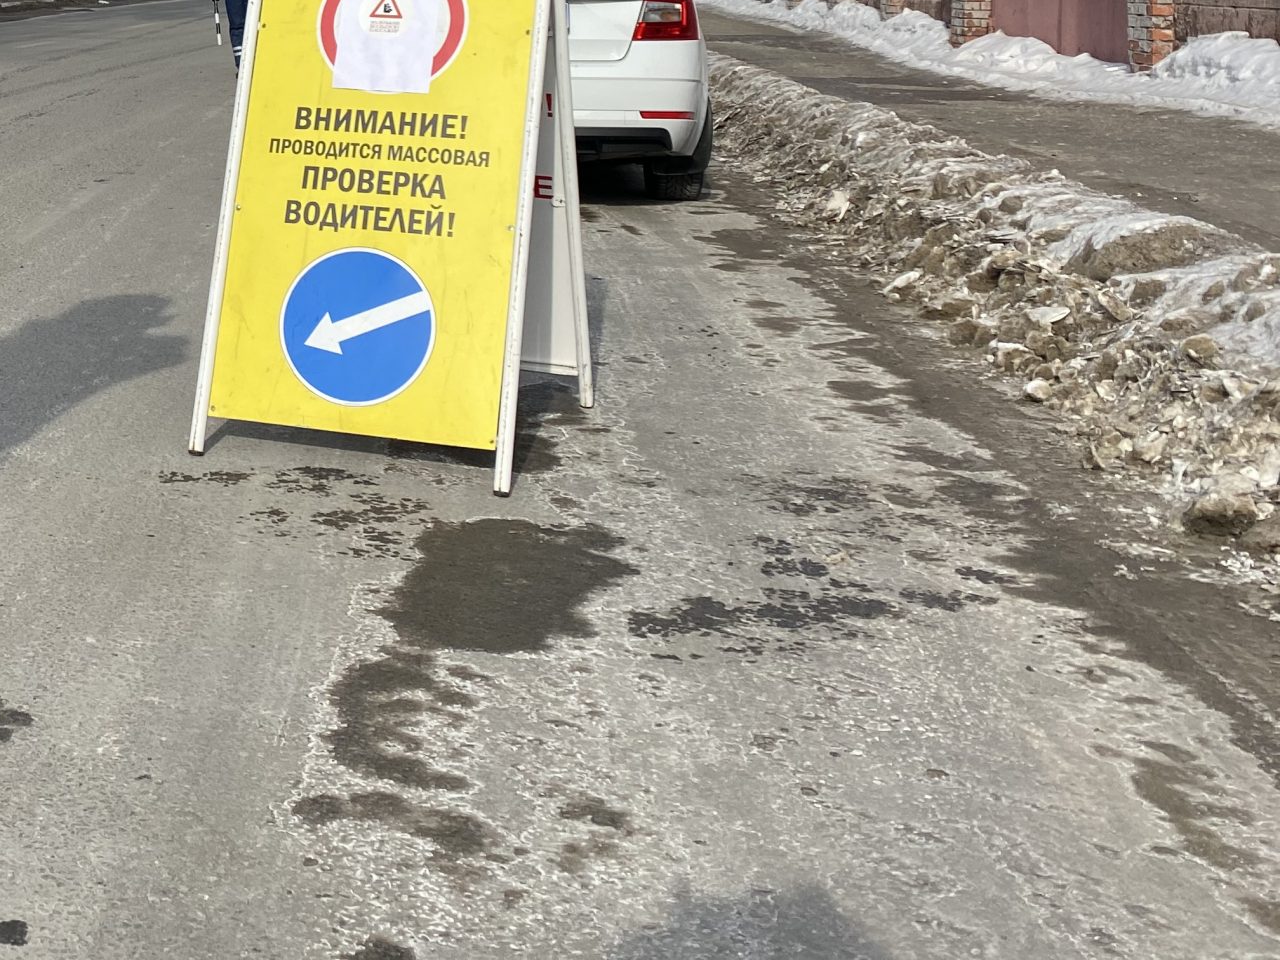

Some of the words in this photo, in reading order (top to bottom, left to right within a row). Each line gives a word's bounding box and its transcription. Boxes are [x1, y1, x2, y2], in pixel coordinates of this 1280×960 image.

[295, 106, 468, 139] ВНИМАНИЕ!
[269, 138, 381, 160] ПРОВОДИТСЯ
[387, 145, 490, 168] МАССОВАЯ
[301, 166, 446, 199] ПРОВЕРКА
[284, 200, 455, 237] ВОДИТЕЛЕЙ!
